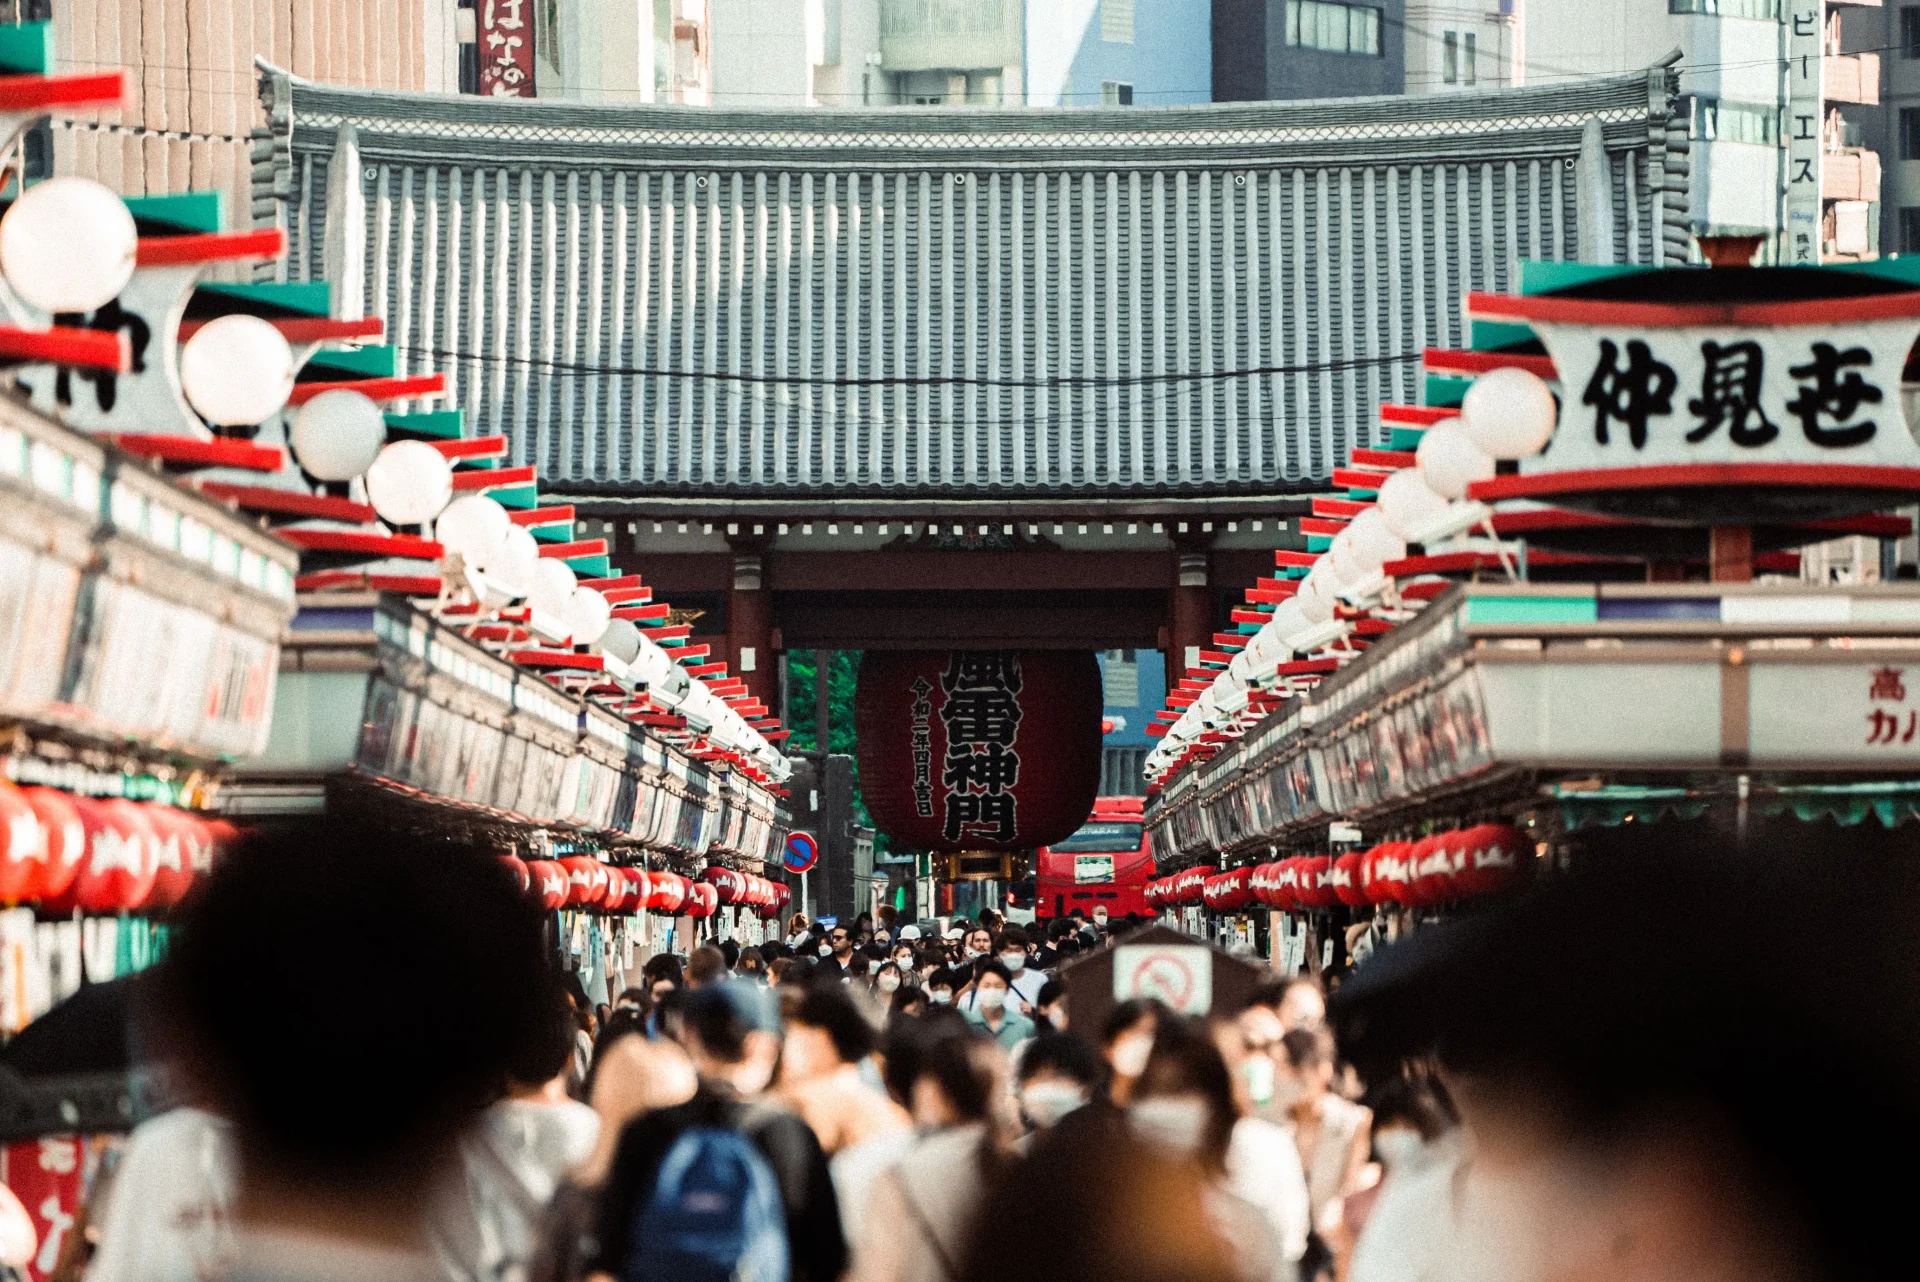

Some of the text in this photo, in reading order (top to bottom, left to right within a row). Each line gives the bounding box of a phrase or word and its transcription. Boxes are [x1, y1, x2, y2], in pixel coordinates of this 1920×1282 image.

[1791, 9, 1818, 183] ビーエス
[1796, 233, 1810, 264] 株式
[1582, 338, 1883, 450] 仲見世
[910, 676, 934, 817] 令和二年四月吉日
[939, 652, 1023, 842] 風雷神門
